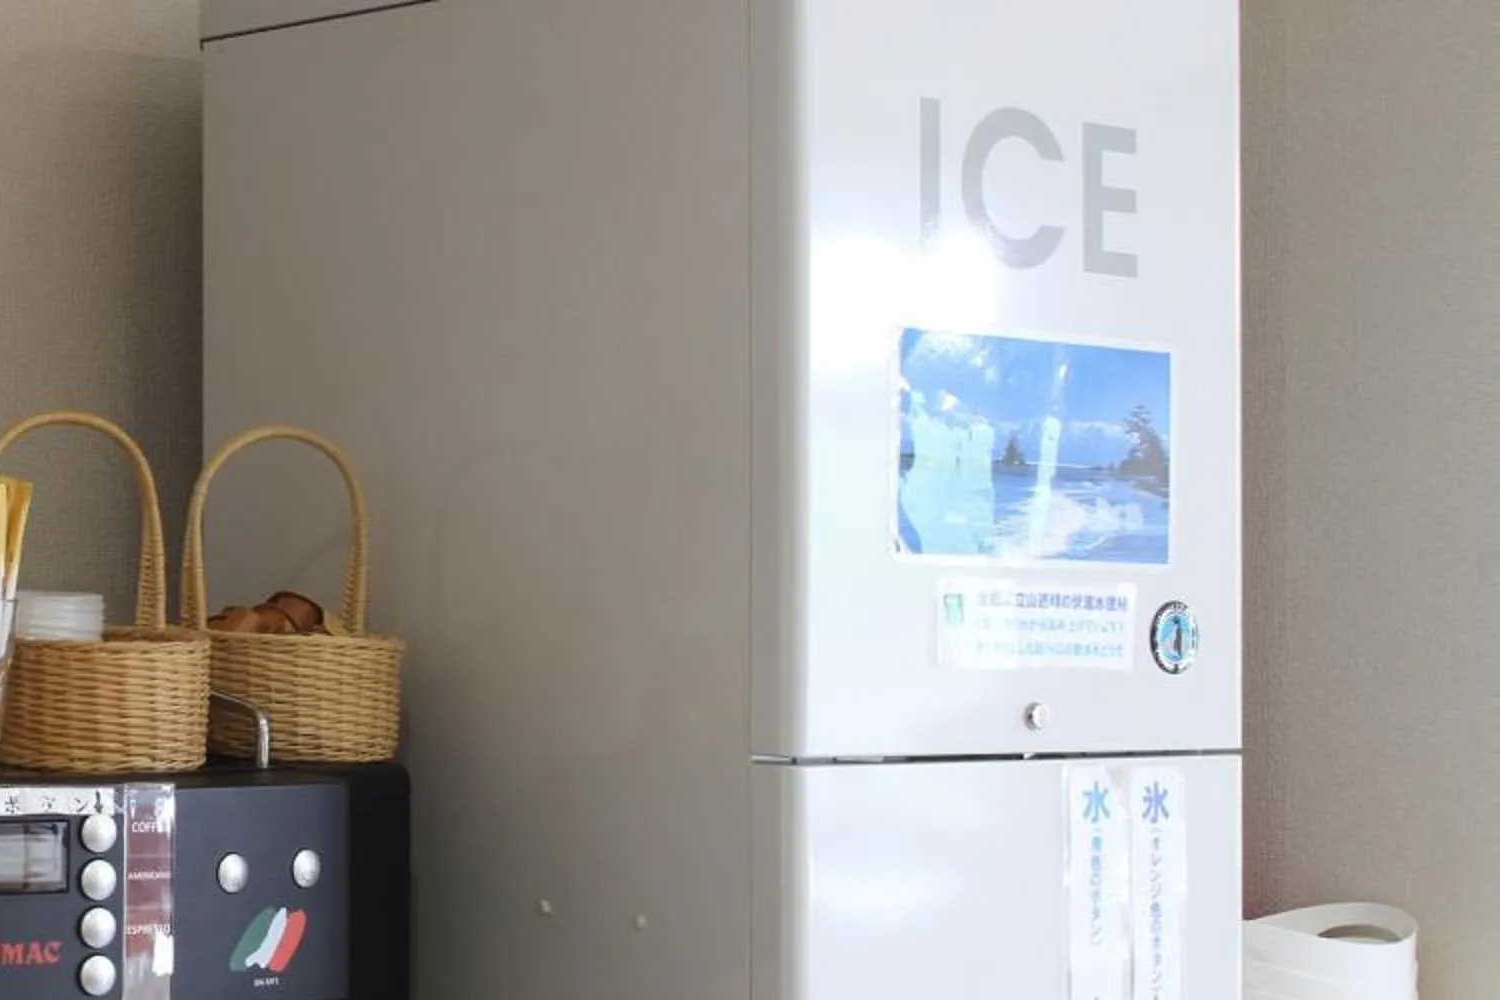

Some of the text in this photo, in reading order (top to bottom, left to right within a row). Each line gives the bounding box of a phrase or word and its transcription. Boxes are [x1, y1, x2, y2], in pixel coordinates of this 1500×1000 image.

[919, 96, 1139, 279] ICE
[1082, 780, 1111, 824] 水
[1142, 780, 1171, 824] 氷
[131, 821, 170, 833] COFF
